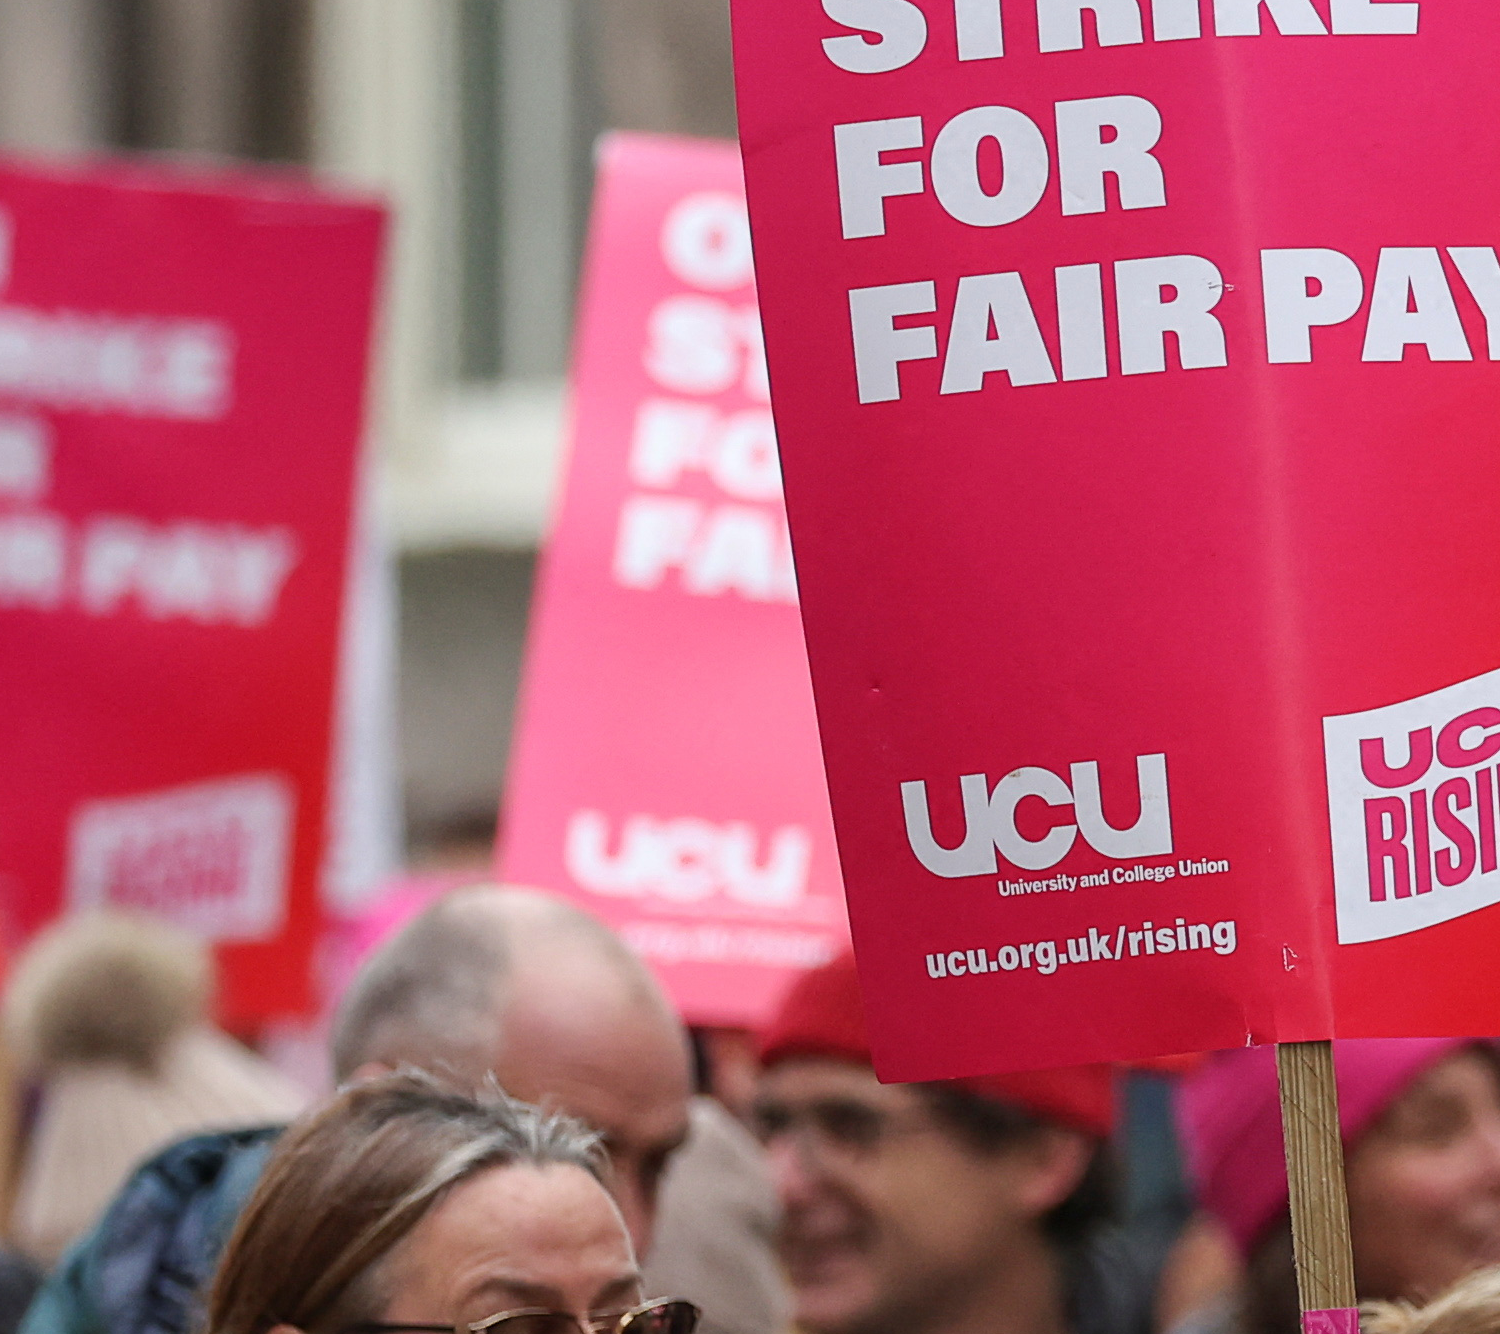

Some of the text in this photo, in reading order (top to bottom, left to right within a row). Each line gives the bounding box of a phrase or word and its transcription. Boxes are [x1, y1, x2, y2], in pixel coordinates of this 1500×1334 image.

[833, 93, 1167, 241] FOR
[847, 253, 1228, 405] FAIR
[998, 858, 1229, 897] University and College Union
[925, 918, 1236, 979] ucu.org.uk/rising
